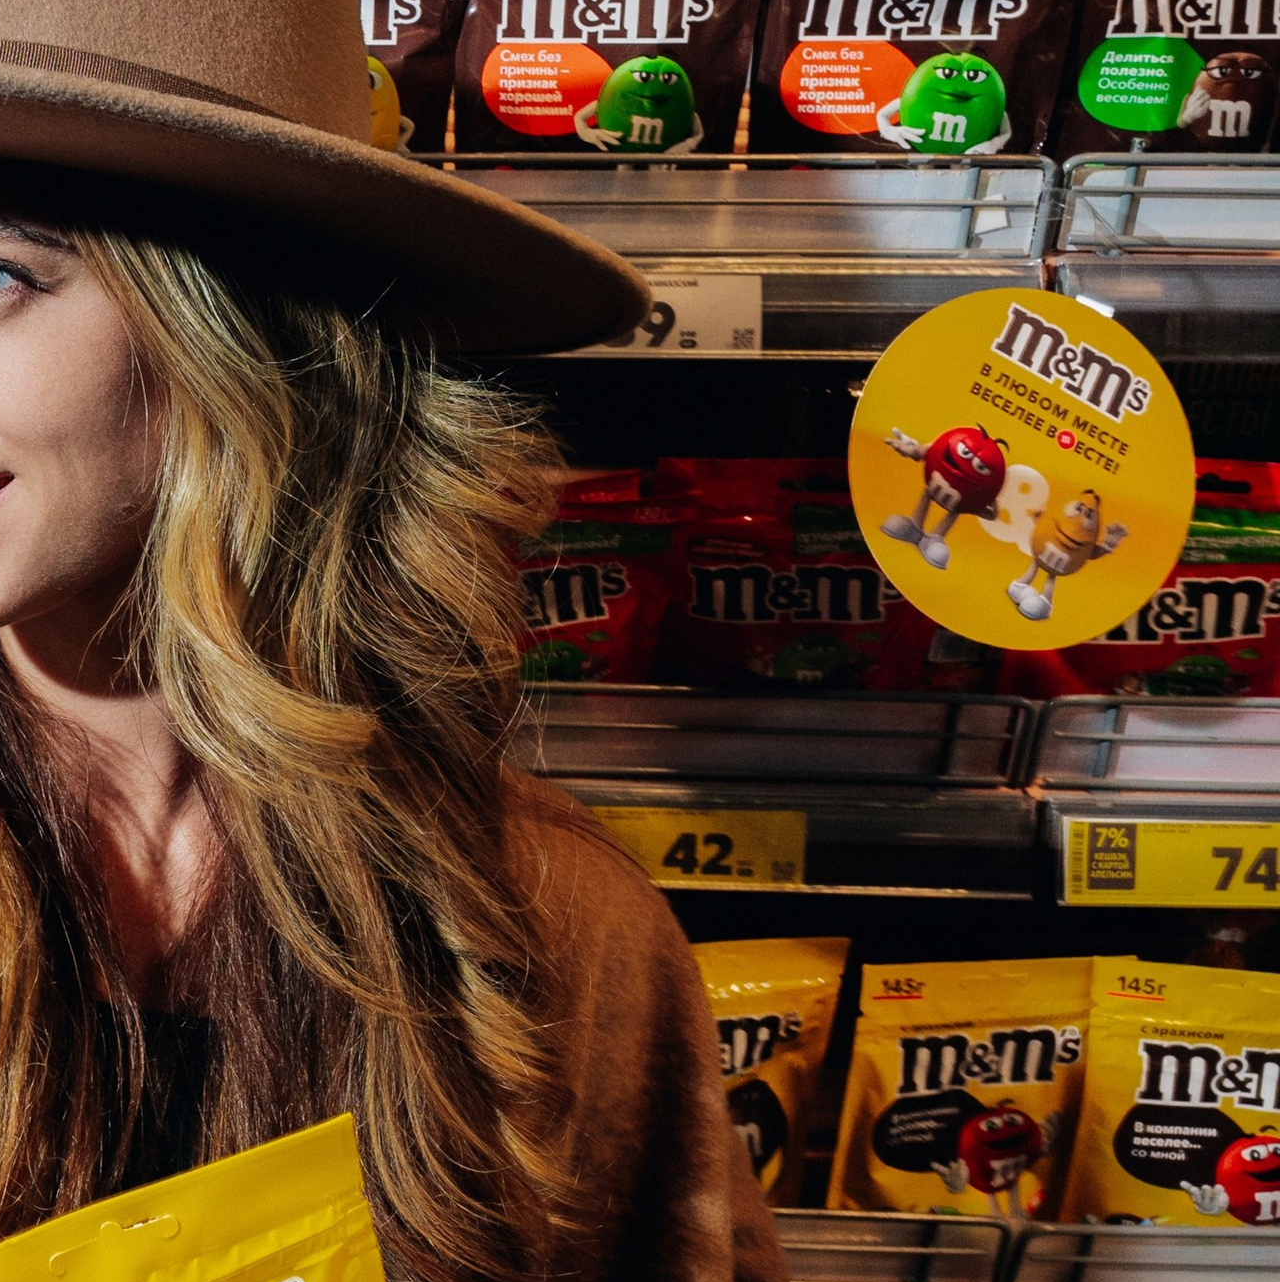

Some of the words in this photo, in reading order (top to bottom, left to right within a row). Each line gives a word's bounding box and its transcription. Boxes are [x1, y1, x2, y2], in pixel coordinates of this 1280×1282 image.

[500, 50, 535, 62] Смех
[538, 49, 562, 62] без
[802, 48, 837, 61] Смех
[840, 47, 864, 60] без
[1102, 51, 1175, 65] Делиться
[499, 66, 558, 77] причины
[801, 64, 860, 76] причины
[1100, 66, 1168, 77] полезно.
[499, 78, 558, 90] признак
[800, 77, 860, 89] признак
[1098, 78, 1171, 91] Особенно
[499, 90, 563, 104] хорошей
[798, 89, 865, 103] хорошей
[1096, 92, 1169, 105] весельем!
[797, 102, 876, 114] компании!
[970, 382, 1045, 431] ВЕСЕЛЕЕ
[979, 363, 992, 377] В
[994, 373, 1069, 421] ЛЮБОМ
[1072, 415, 1130, 456] МЕСТЕ
[1095, 827, 1130, 848] 7%
[663, 833, 733, 875] 42
[1212, 847, 1280, 891] 74
[1116, 976, 1167, 996] 145г
[1151, 1027, 1225, 1041] арахисом
[1134, 1121, 1144, 1133] В
[1146, 1124, 1218, 1137] компании
[1131, 1149, 1147, 1158] со
[1150, 1148, 1186, 1161] мной
